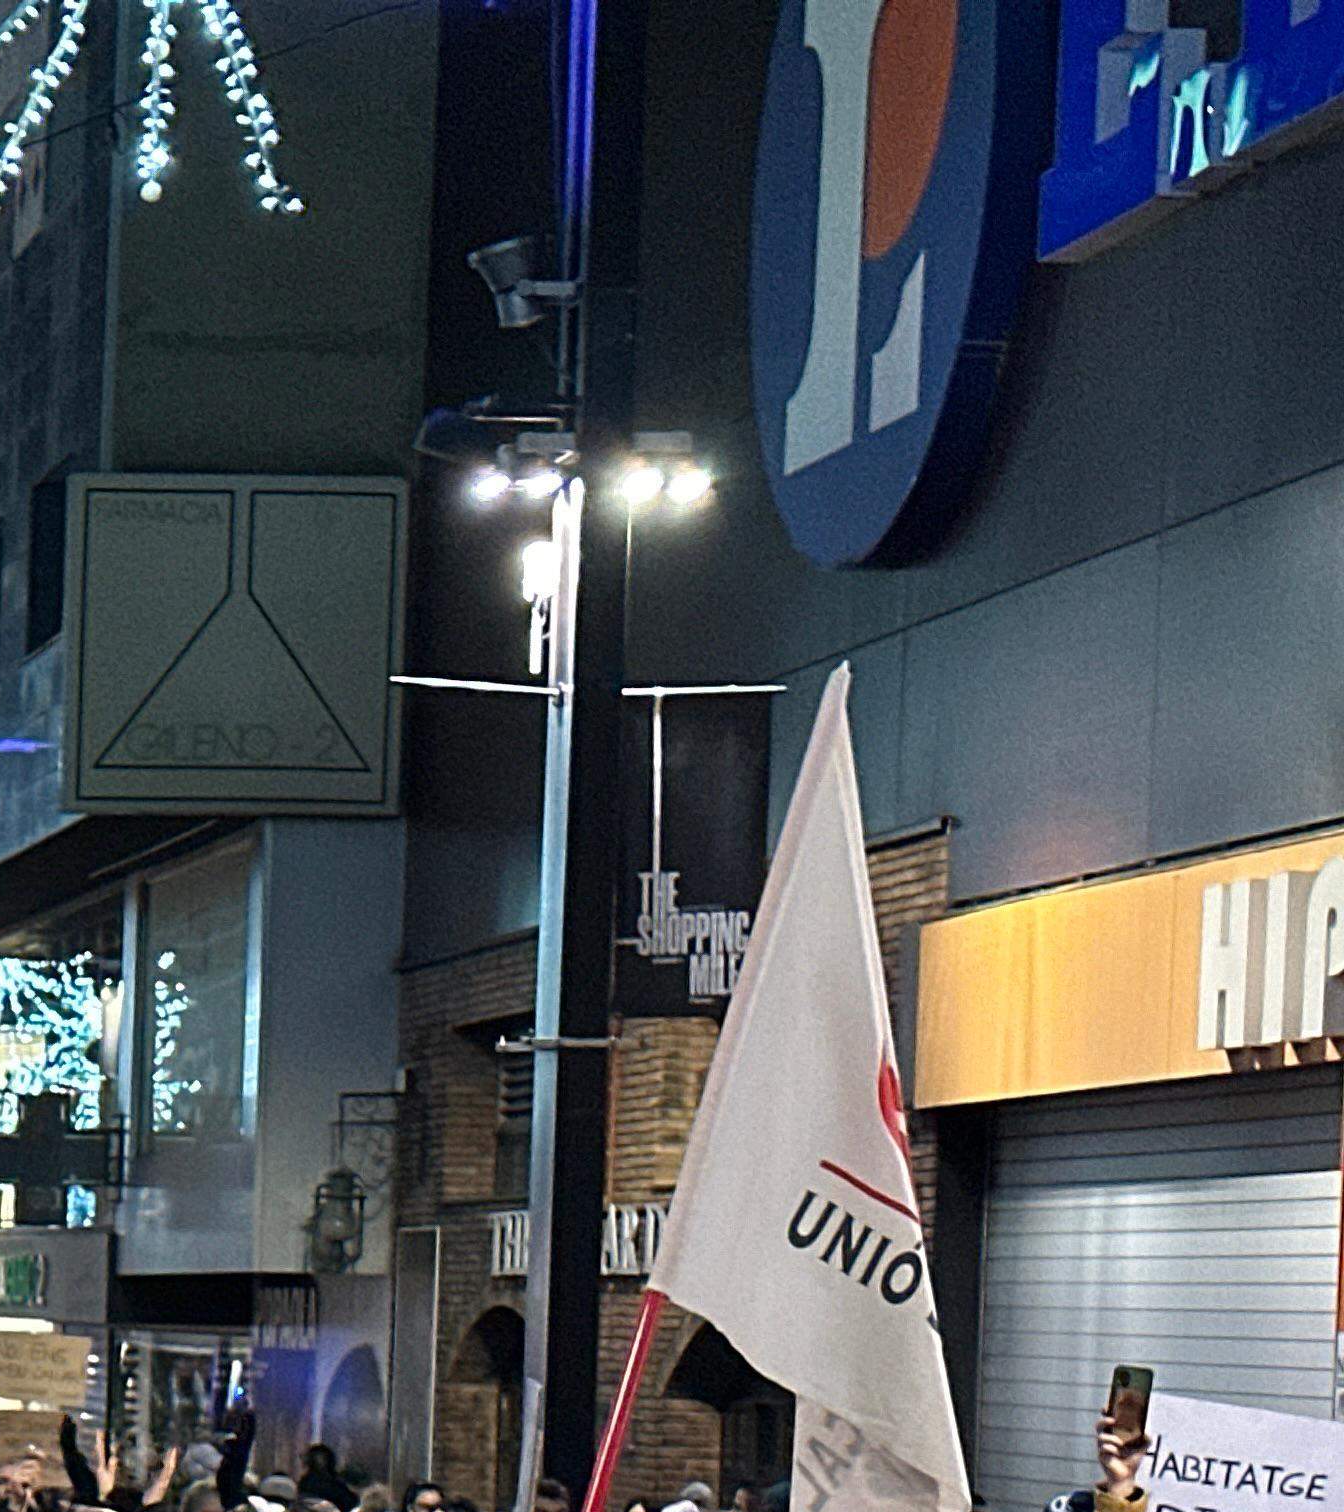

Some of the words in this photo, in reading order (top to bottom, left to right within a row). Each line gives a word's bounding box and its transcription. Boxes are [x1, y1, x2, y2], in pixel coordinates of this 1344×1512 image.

[637, 870, 680, 913] THE
[636, 911, 750, 957] SHOPPING
[787, 1190, 923, 1305] UNIÓ
[1146, 1434, 1328, 1501] HABITATGE
